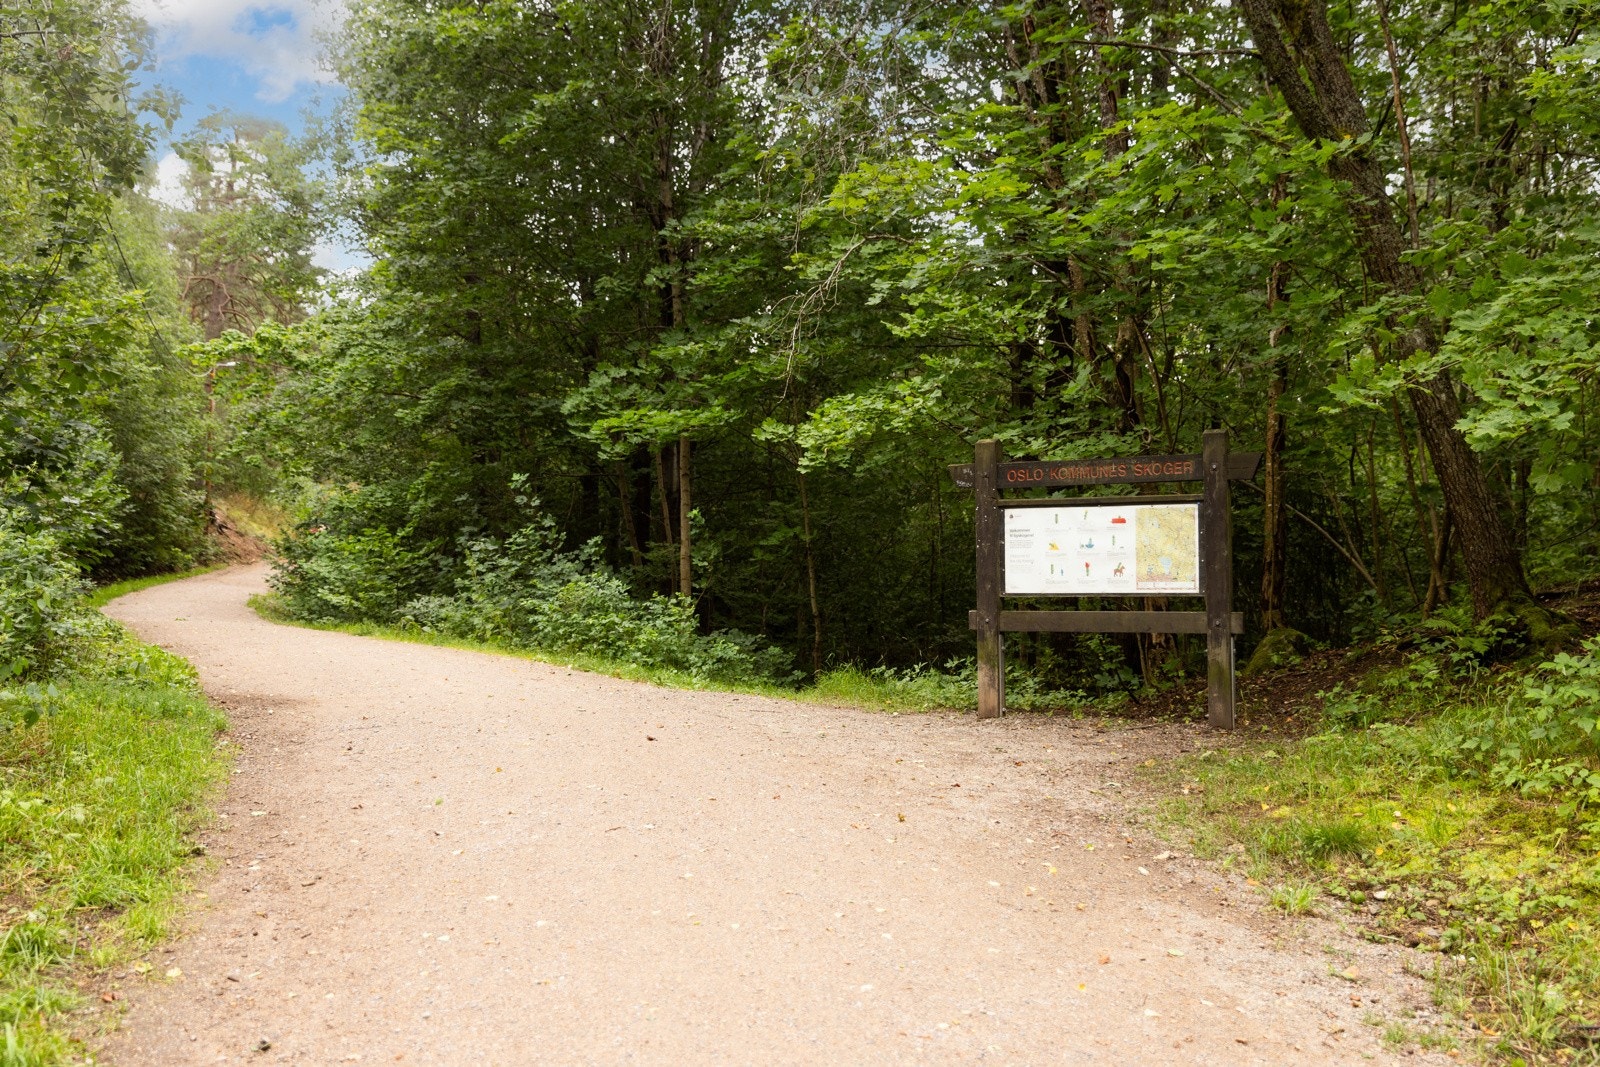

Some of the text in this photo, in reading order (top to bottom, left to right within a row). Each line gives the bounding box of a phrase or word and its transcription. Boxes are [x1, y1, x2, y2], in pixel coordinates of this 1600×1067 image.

[1007, 460, 1193, 482] OSLO KOMMUNES SKOGER
